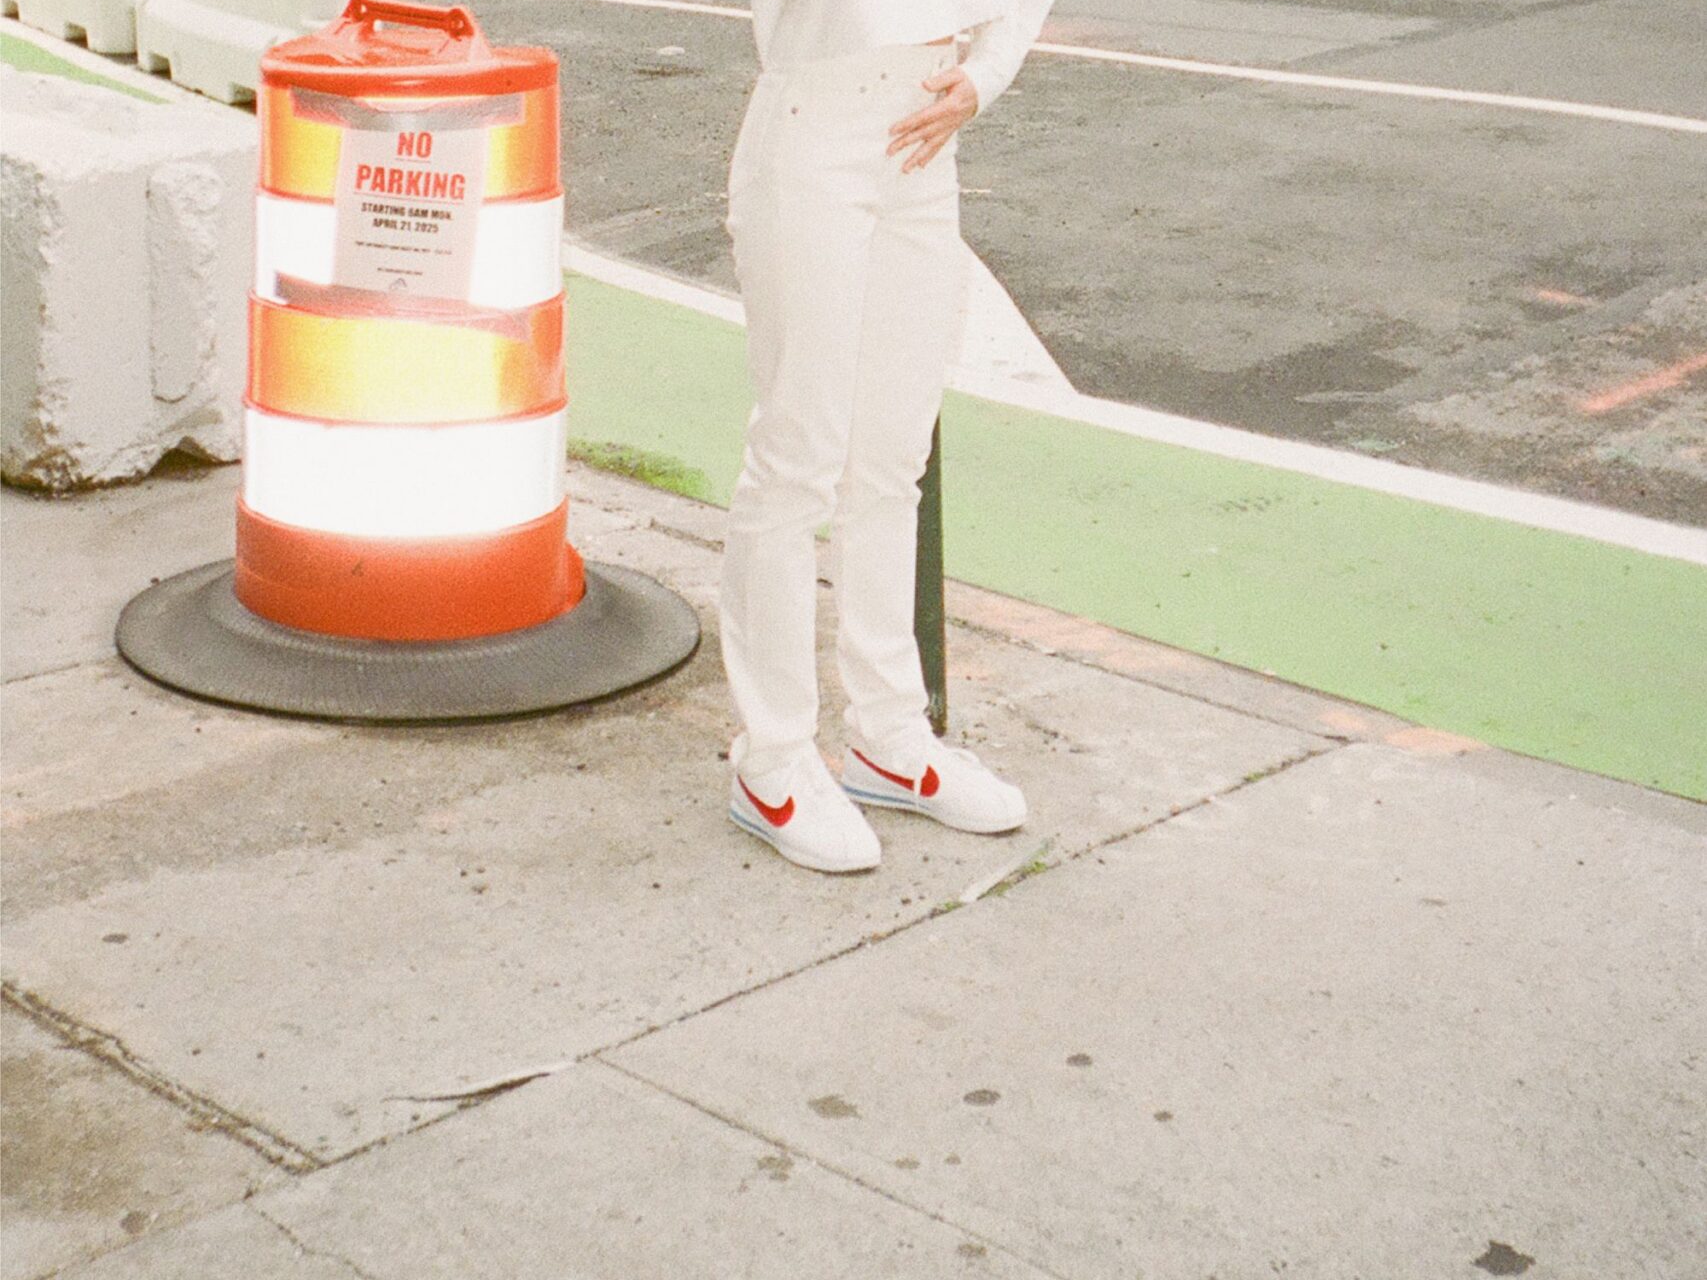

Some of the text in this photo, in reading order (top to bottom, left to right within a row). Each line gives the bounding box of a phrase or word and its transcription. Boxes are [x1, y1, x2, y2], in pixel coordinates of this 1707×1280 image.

[396, 130, 433, 158] NO
[355, 164, 465, 200] PARKING
[361, 202, 405, 216] STARTING
[373, 218, 439, 233] APRIL 21 2025
